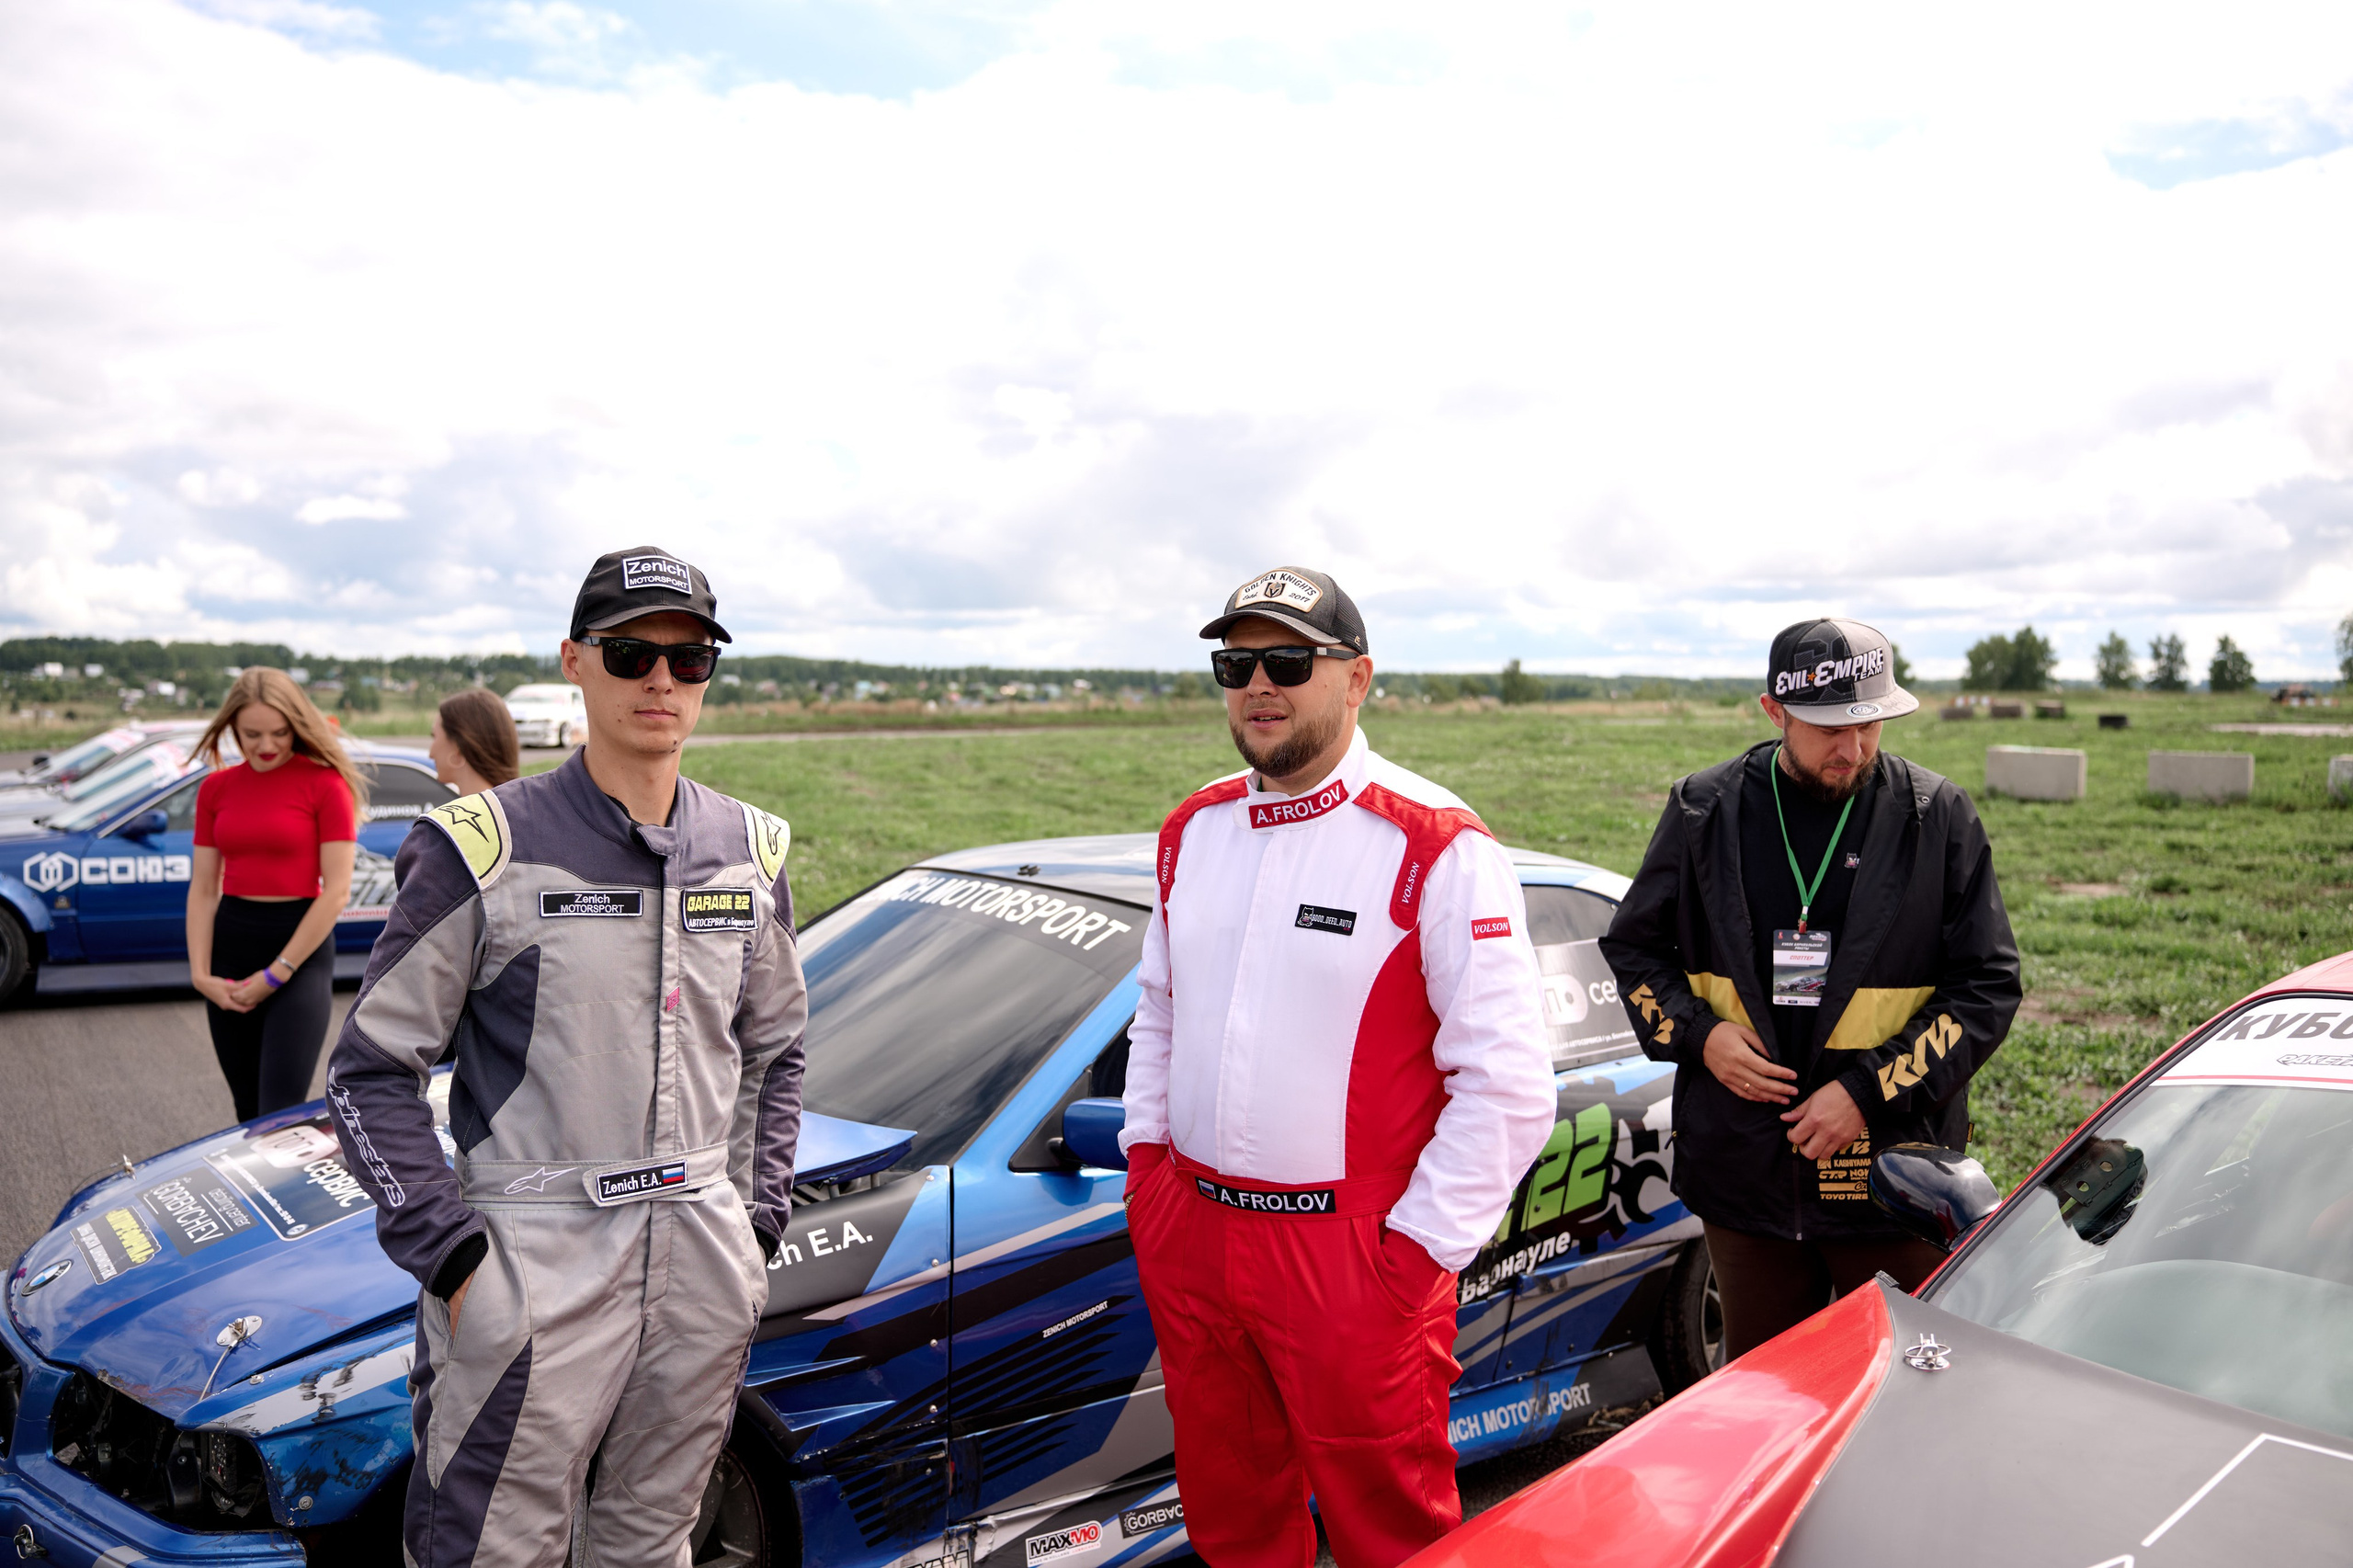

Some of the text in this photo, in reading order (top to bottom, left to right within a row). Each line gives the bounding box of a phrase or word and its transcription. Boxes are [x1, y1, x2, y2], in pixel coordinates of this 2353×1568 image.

[628, 560, 688, 579] Zenich
[629, 575, 688, 589] MOTORSPORT
[1245, 573, 1317, 597] GOLDEN KNIGHTS
[1288, 592, 1312, 603] 2017
[1775, 669, 1810, 696] EVIL
[1813, 647, 1884, 687] EMPIRE
[1853, 663, 1884, 682] TEAM
[1256, 784, 1341, 824] A.FROLOV
[80, 854, 192, 885] СОЮЗ
[1161, 846, 1172, 884] VOLSON
[1401, 861, 1421, 904] VOLSON
[560, 903, 625, 914] MOTORSPORT
[574, 893, 611, 904] Zenich
[687, 893, 751, 912] GARAGE 22
[688, 916, 727, 928] АВТОСЕРВИС
[920, 878, 1131, 951] MOTORSPORT
[1473, 922, 1508, 935] VOLSON
[1877, 1013, 1963, 1102] KYB
[1519, 1102, 1613, 1233] 22
[1833, 1158, 1871, 1168] KASHIYAMA
[302, 1158, 370, 1209] сервис
[603, 1172, 663, 1196] Zenich E.A.
[1220, 1187, 1329, 1211] A.FROLOV
[1819, 1193, 1846, 1201] TOYO
[225, 1206, 252, 1228] center
[807, 1221, 874, 1257] E.A.
[1041, 1300, 1108, 1339] ZENICH MOTORSPORT
[1029, 1525, 1099, 1559] MAXMO
